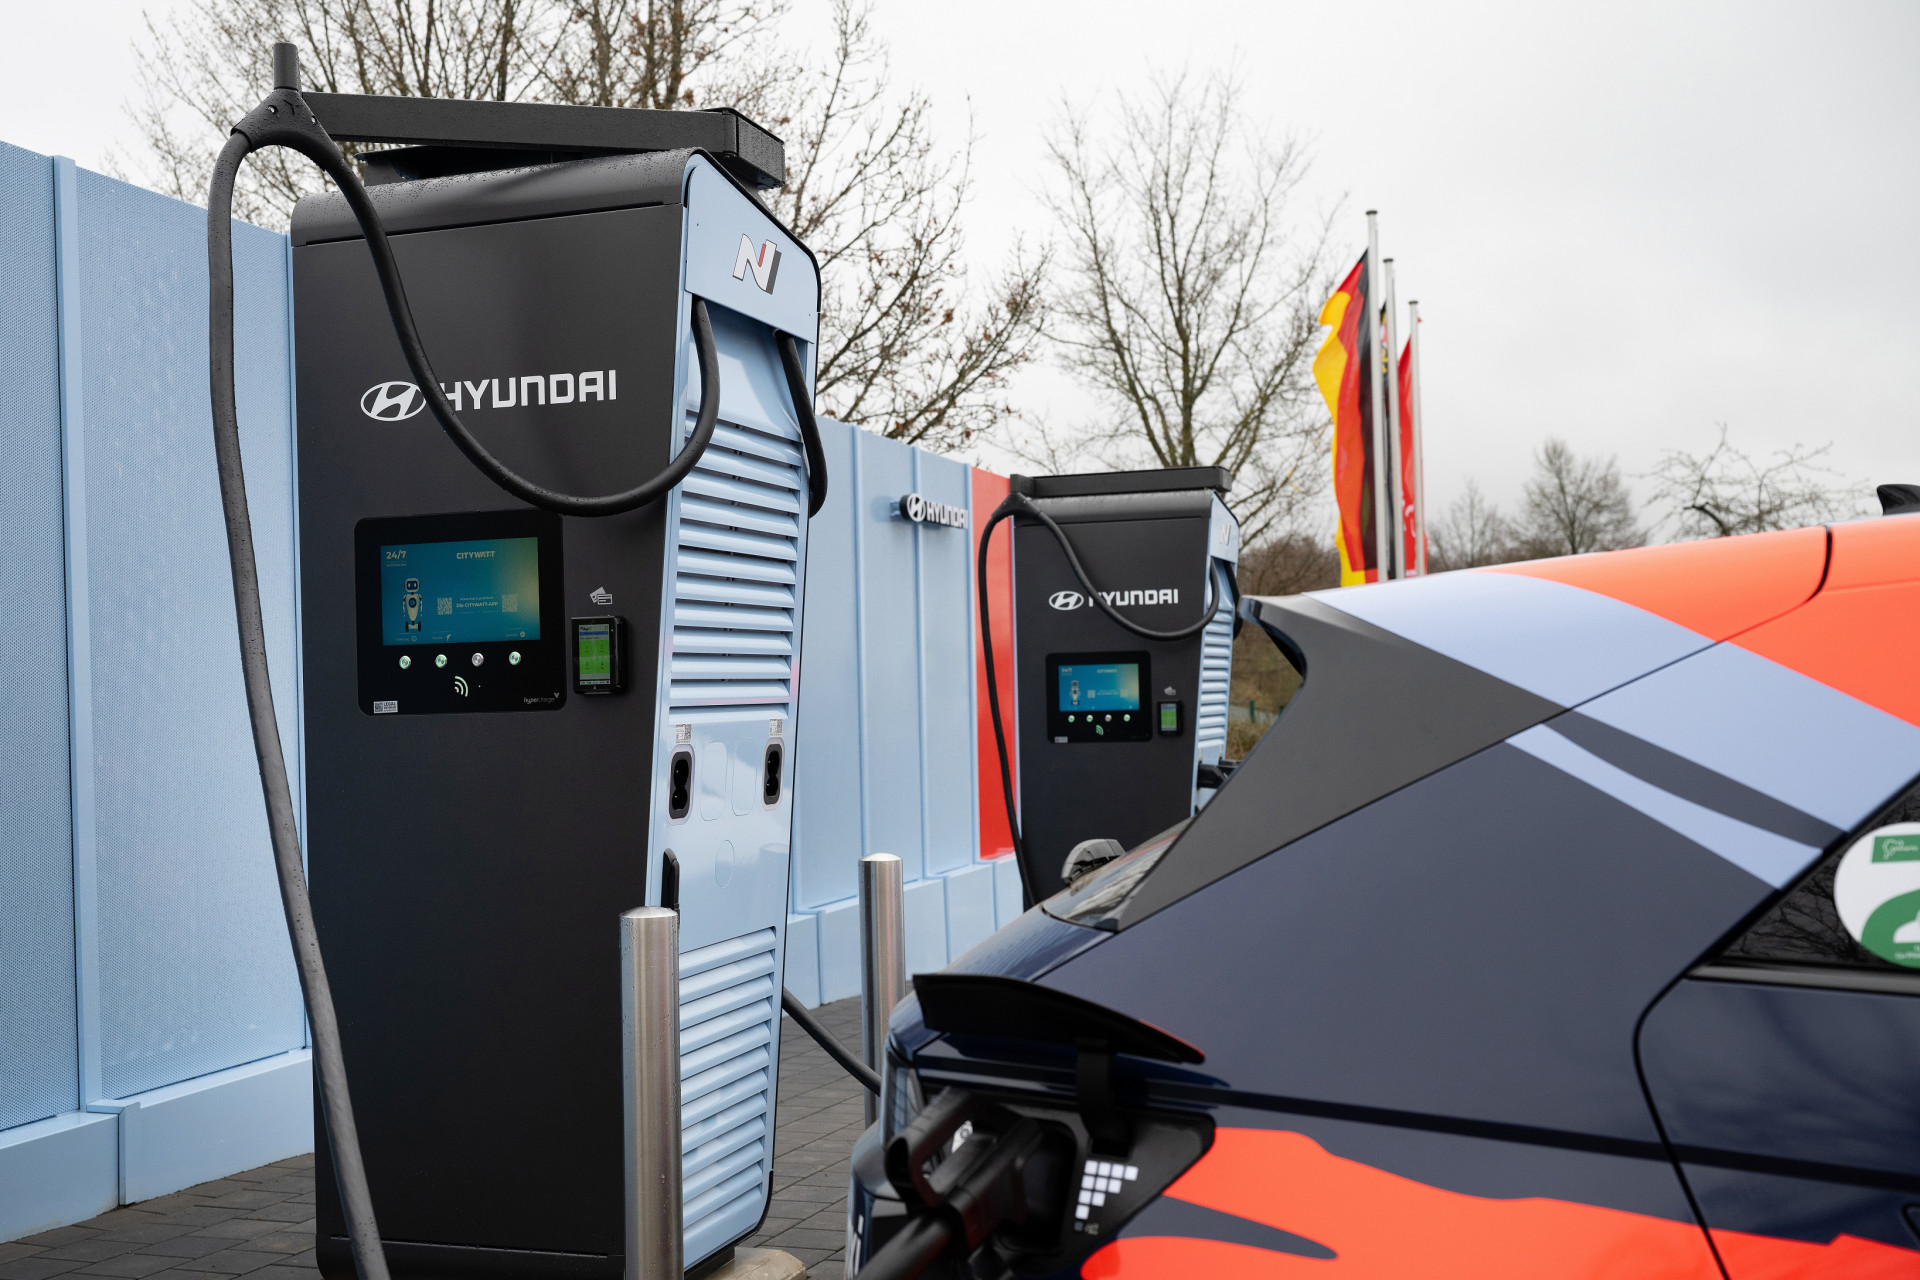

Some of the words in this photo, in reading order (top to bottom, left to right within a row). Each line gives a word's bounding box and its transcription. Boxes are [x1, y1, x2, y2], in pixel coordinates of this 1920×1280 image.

[440, 370, 617, 411] HYUNDAI
[927, 500, 969, 530] HYUNDAI
[386, 550, 407, 560] 24/7
[456, 550, 496, 559] CITYWATT
